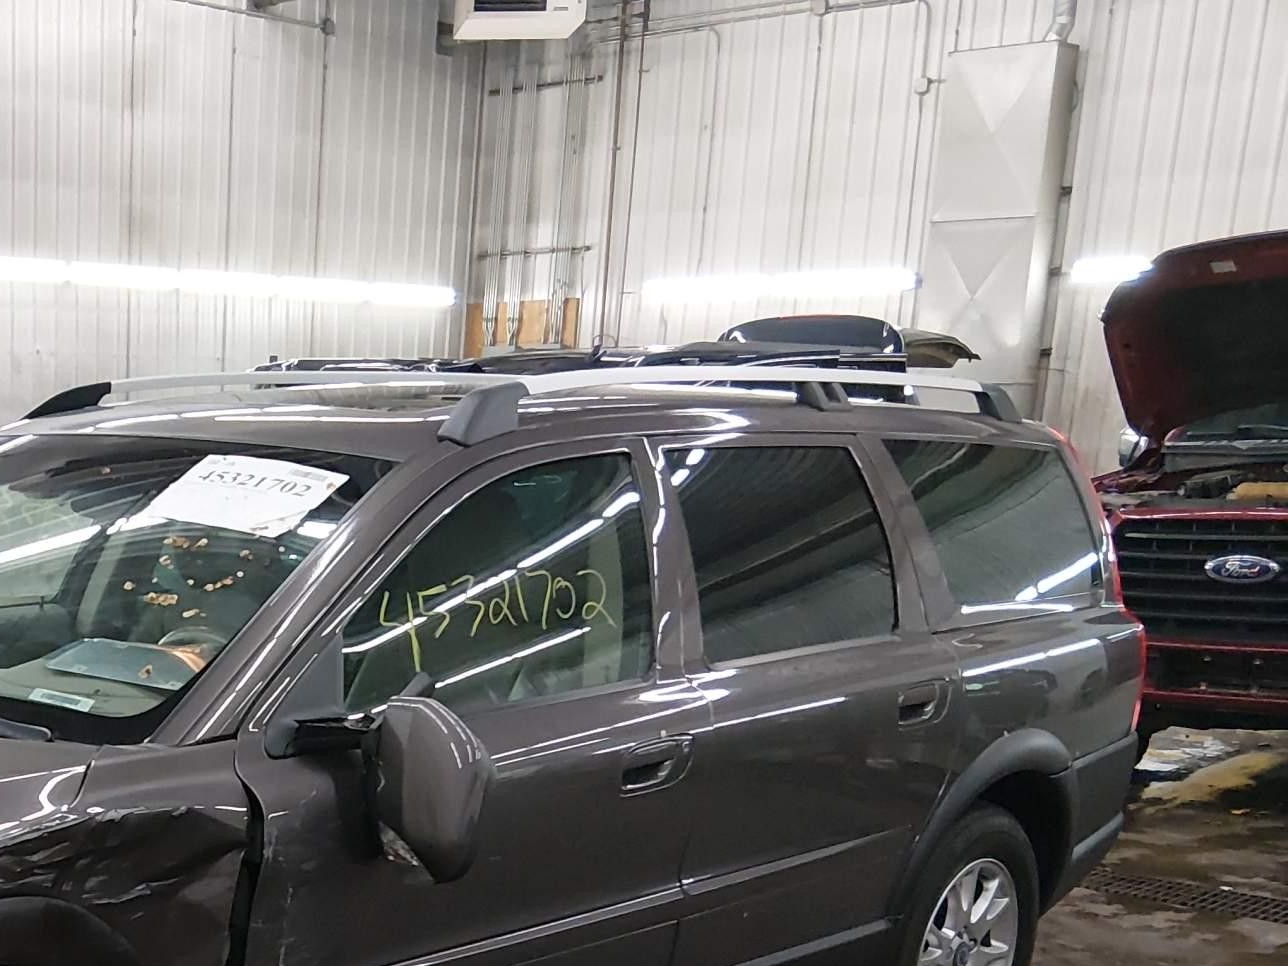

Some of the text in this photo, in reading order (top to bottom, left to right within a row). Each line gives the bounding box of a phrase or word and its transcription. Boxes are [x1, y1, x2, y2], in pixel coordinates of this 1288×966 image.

[197, 469, 313, 497] 45321702
[1220, 560, 1261, 578] Ford
[379, 568, 618, 672] 45321702
